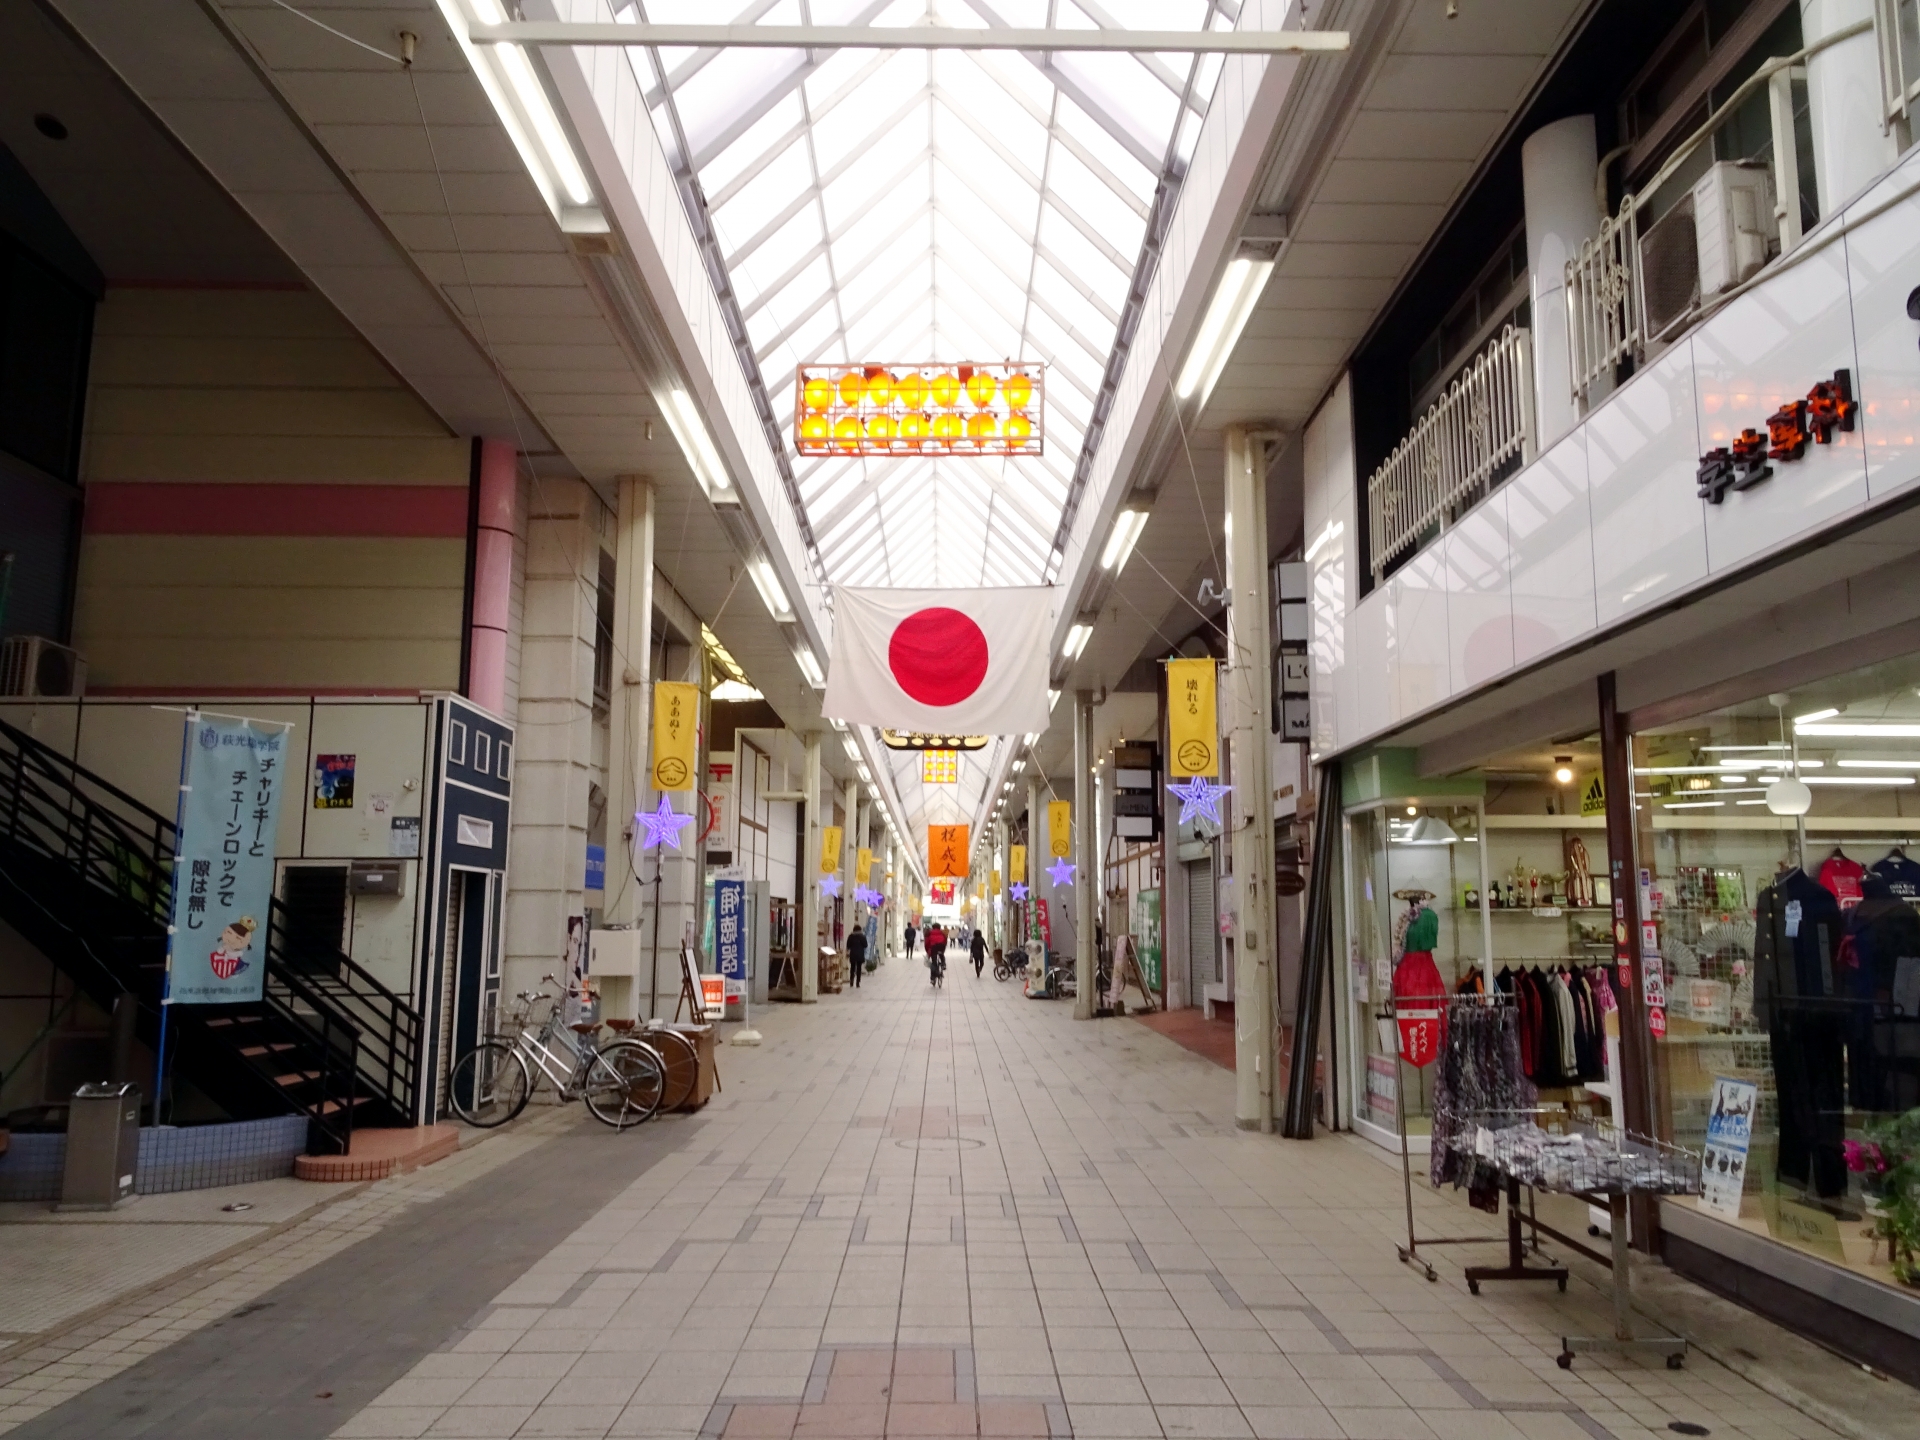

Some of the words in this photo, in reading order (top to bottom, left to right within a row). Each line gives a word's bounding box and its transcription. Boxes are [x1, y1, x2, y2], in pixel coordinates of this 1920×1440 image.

[1186, 678, 1198, 715] 壊れる
[217, 770, 248, 908] チェーンロックで
[248, 758, 276, 857] チャリキーと
